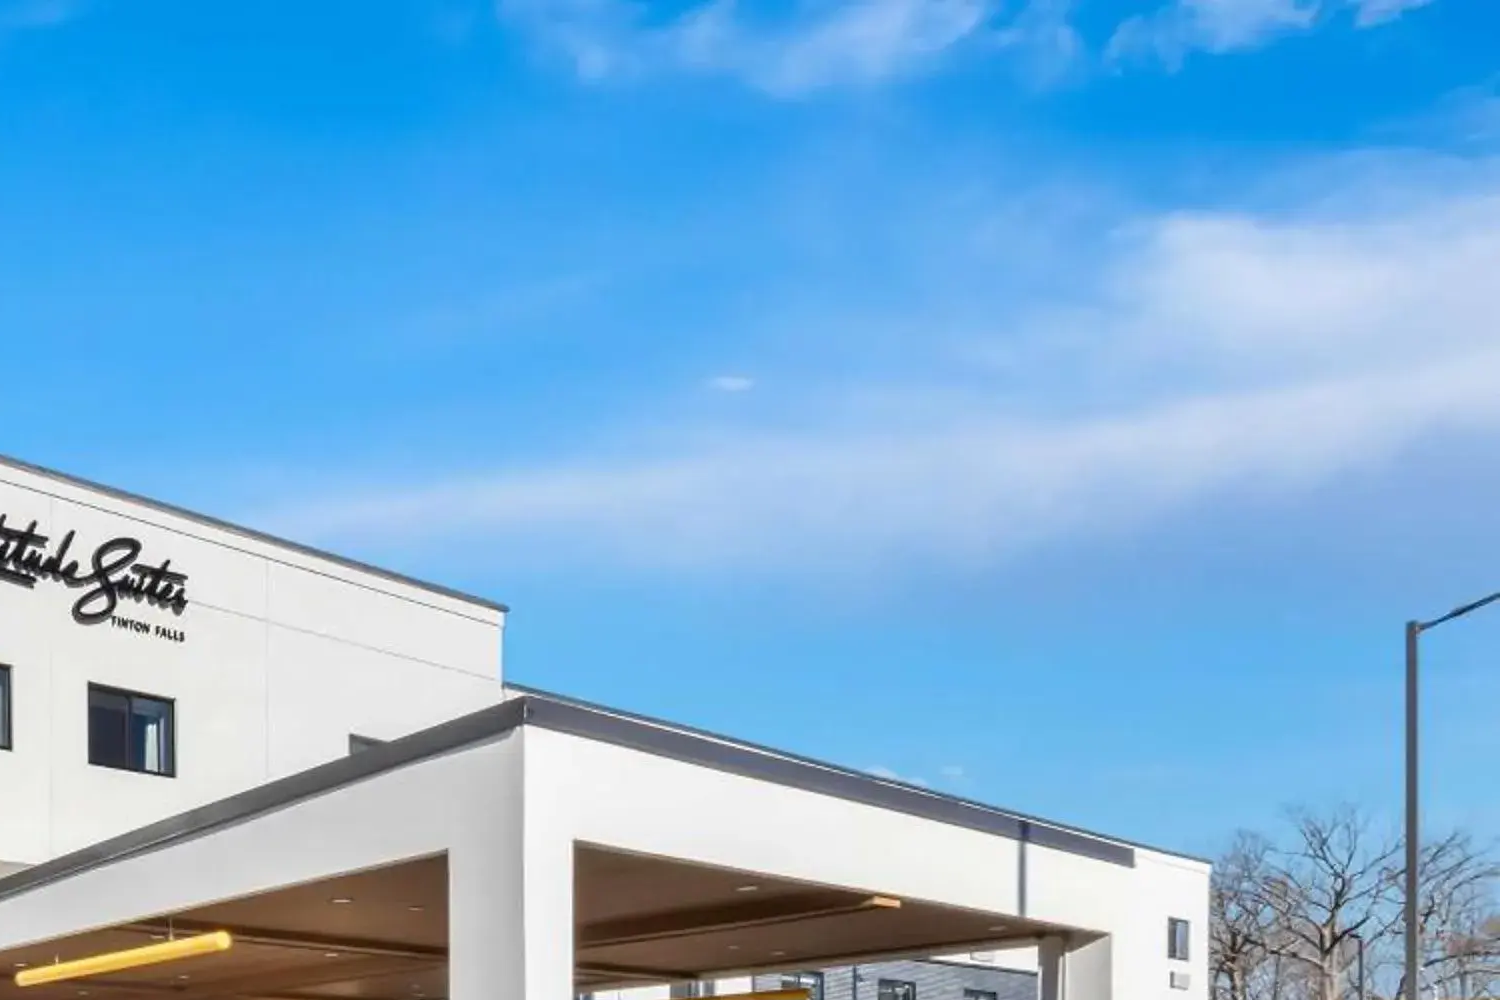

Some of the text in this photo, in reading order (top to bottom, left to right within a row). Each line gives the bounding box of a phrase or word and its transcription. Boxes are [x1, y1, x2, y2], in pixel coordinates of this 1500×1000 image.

[72, 537, 188, 625] Suites
[111, 616, 185, 642] TINTON FALLS
